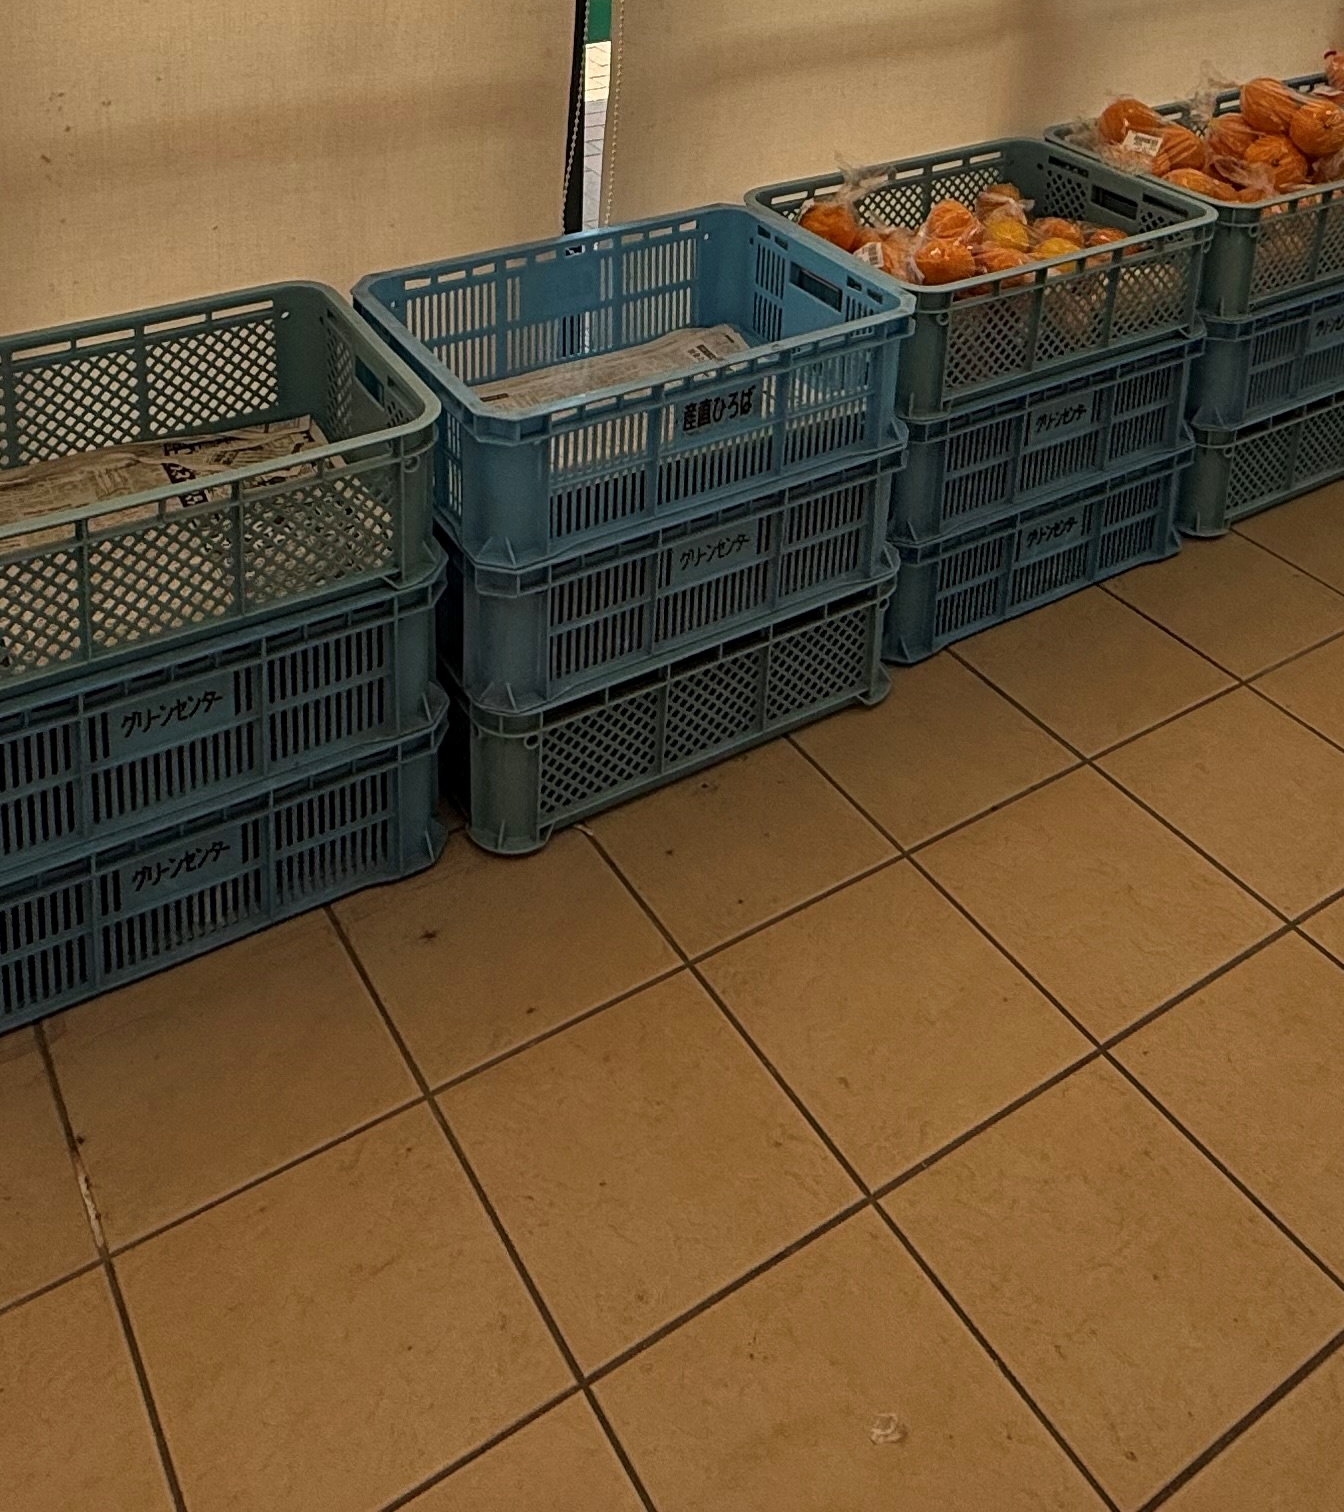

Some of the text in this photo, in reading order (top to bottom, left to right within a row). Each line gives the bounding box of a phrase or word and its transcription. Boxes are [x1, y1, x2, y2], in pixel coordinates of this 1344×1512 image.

[683, 384, 757, 433] 産直ひろば
[679, 533, 751, 571] グリーンセンター
[121, 690, 224, 739] グリーンセンター
[132, 840, 231, 892] グリーンセンター
